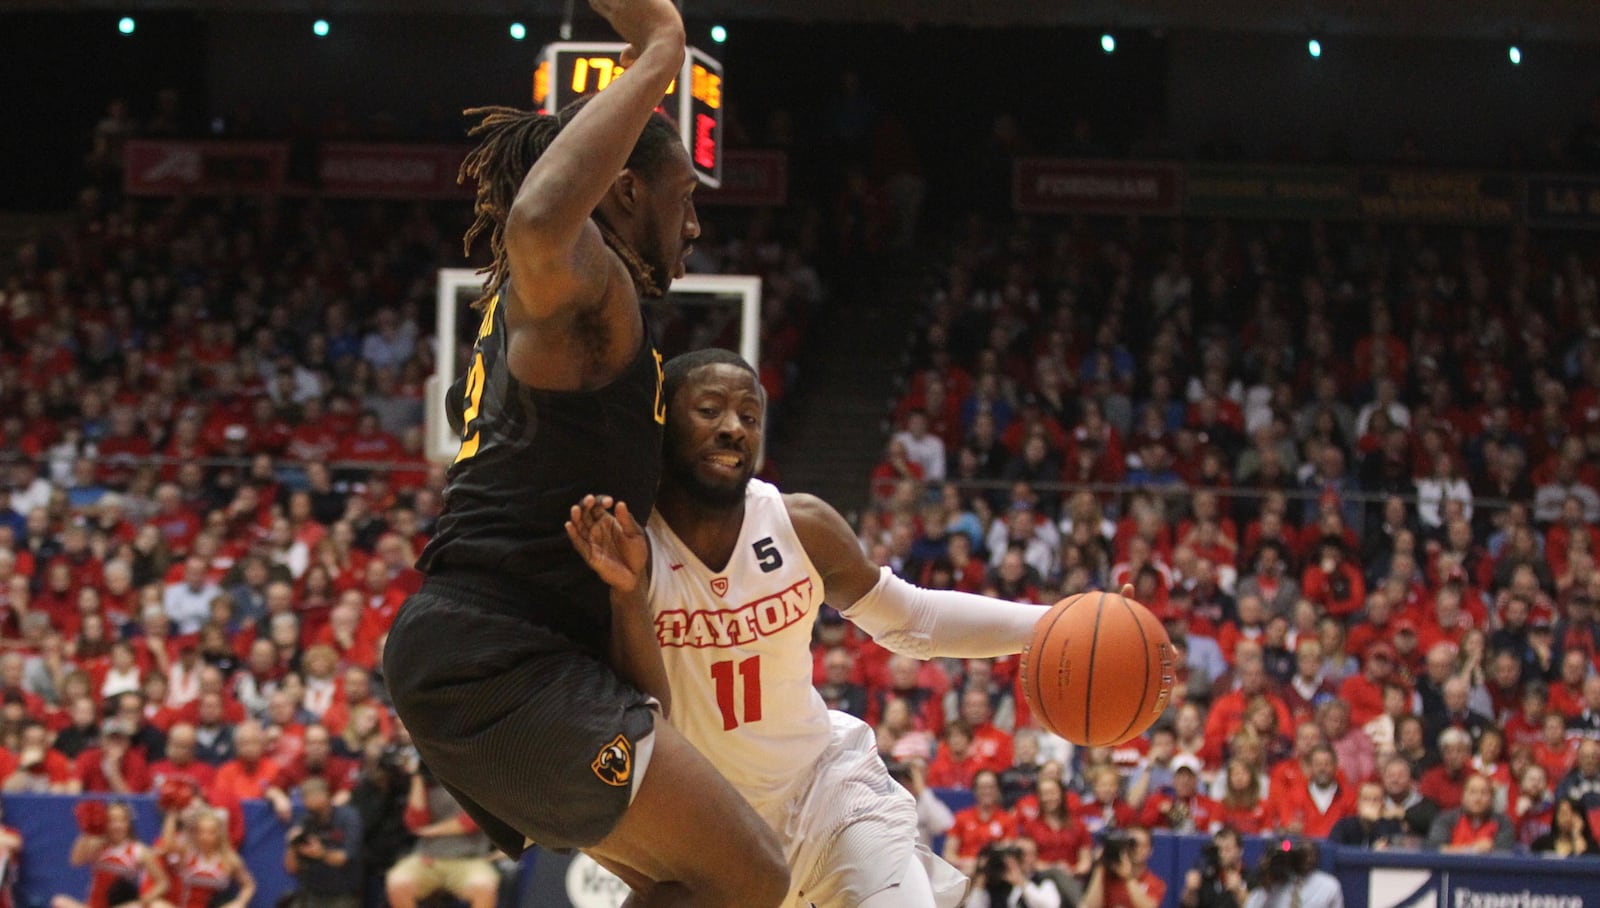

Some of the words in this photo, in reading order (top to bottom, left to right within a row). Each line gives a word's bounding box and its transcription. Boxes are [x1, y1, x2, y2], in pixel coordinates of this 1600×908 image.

[752, 537, 783, 573] 5
[653, 577, 813, 648] DAYTON
[711, 655, 762, 731] 11
[1454, 887, 1584, 908] Experience
